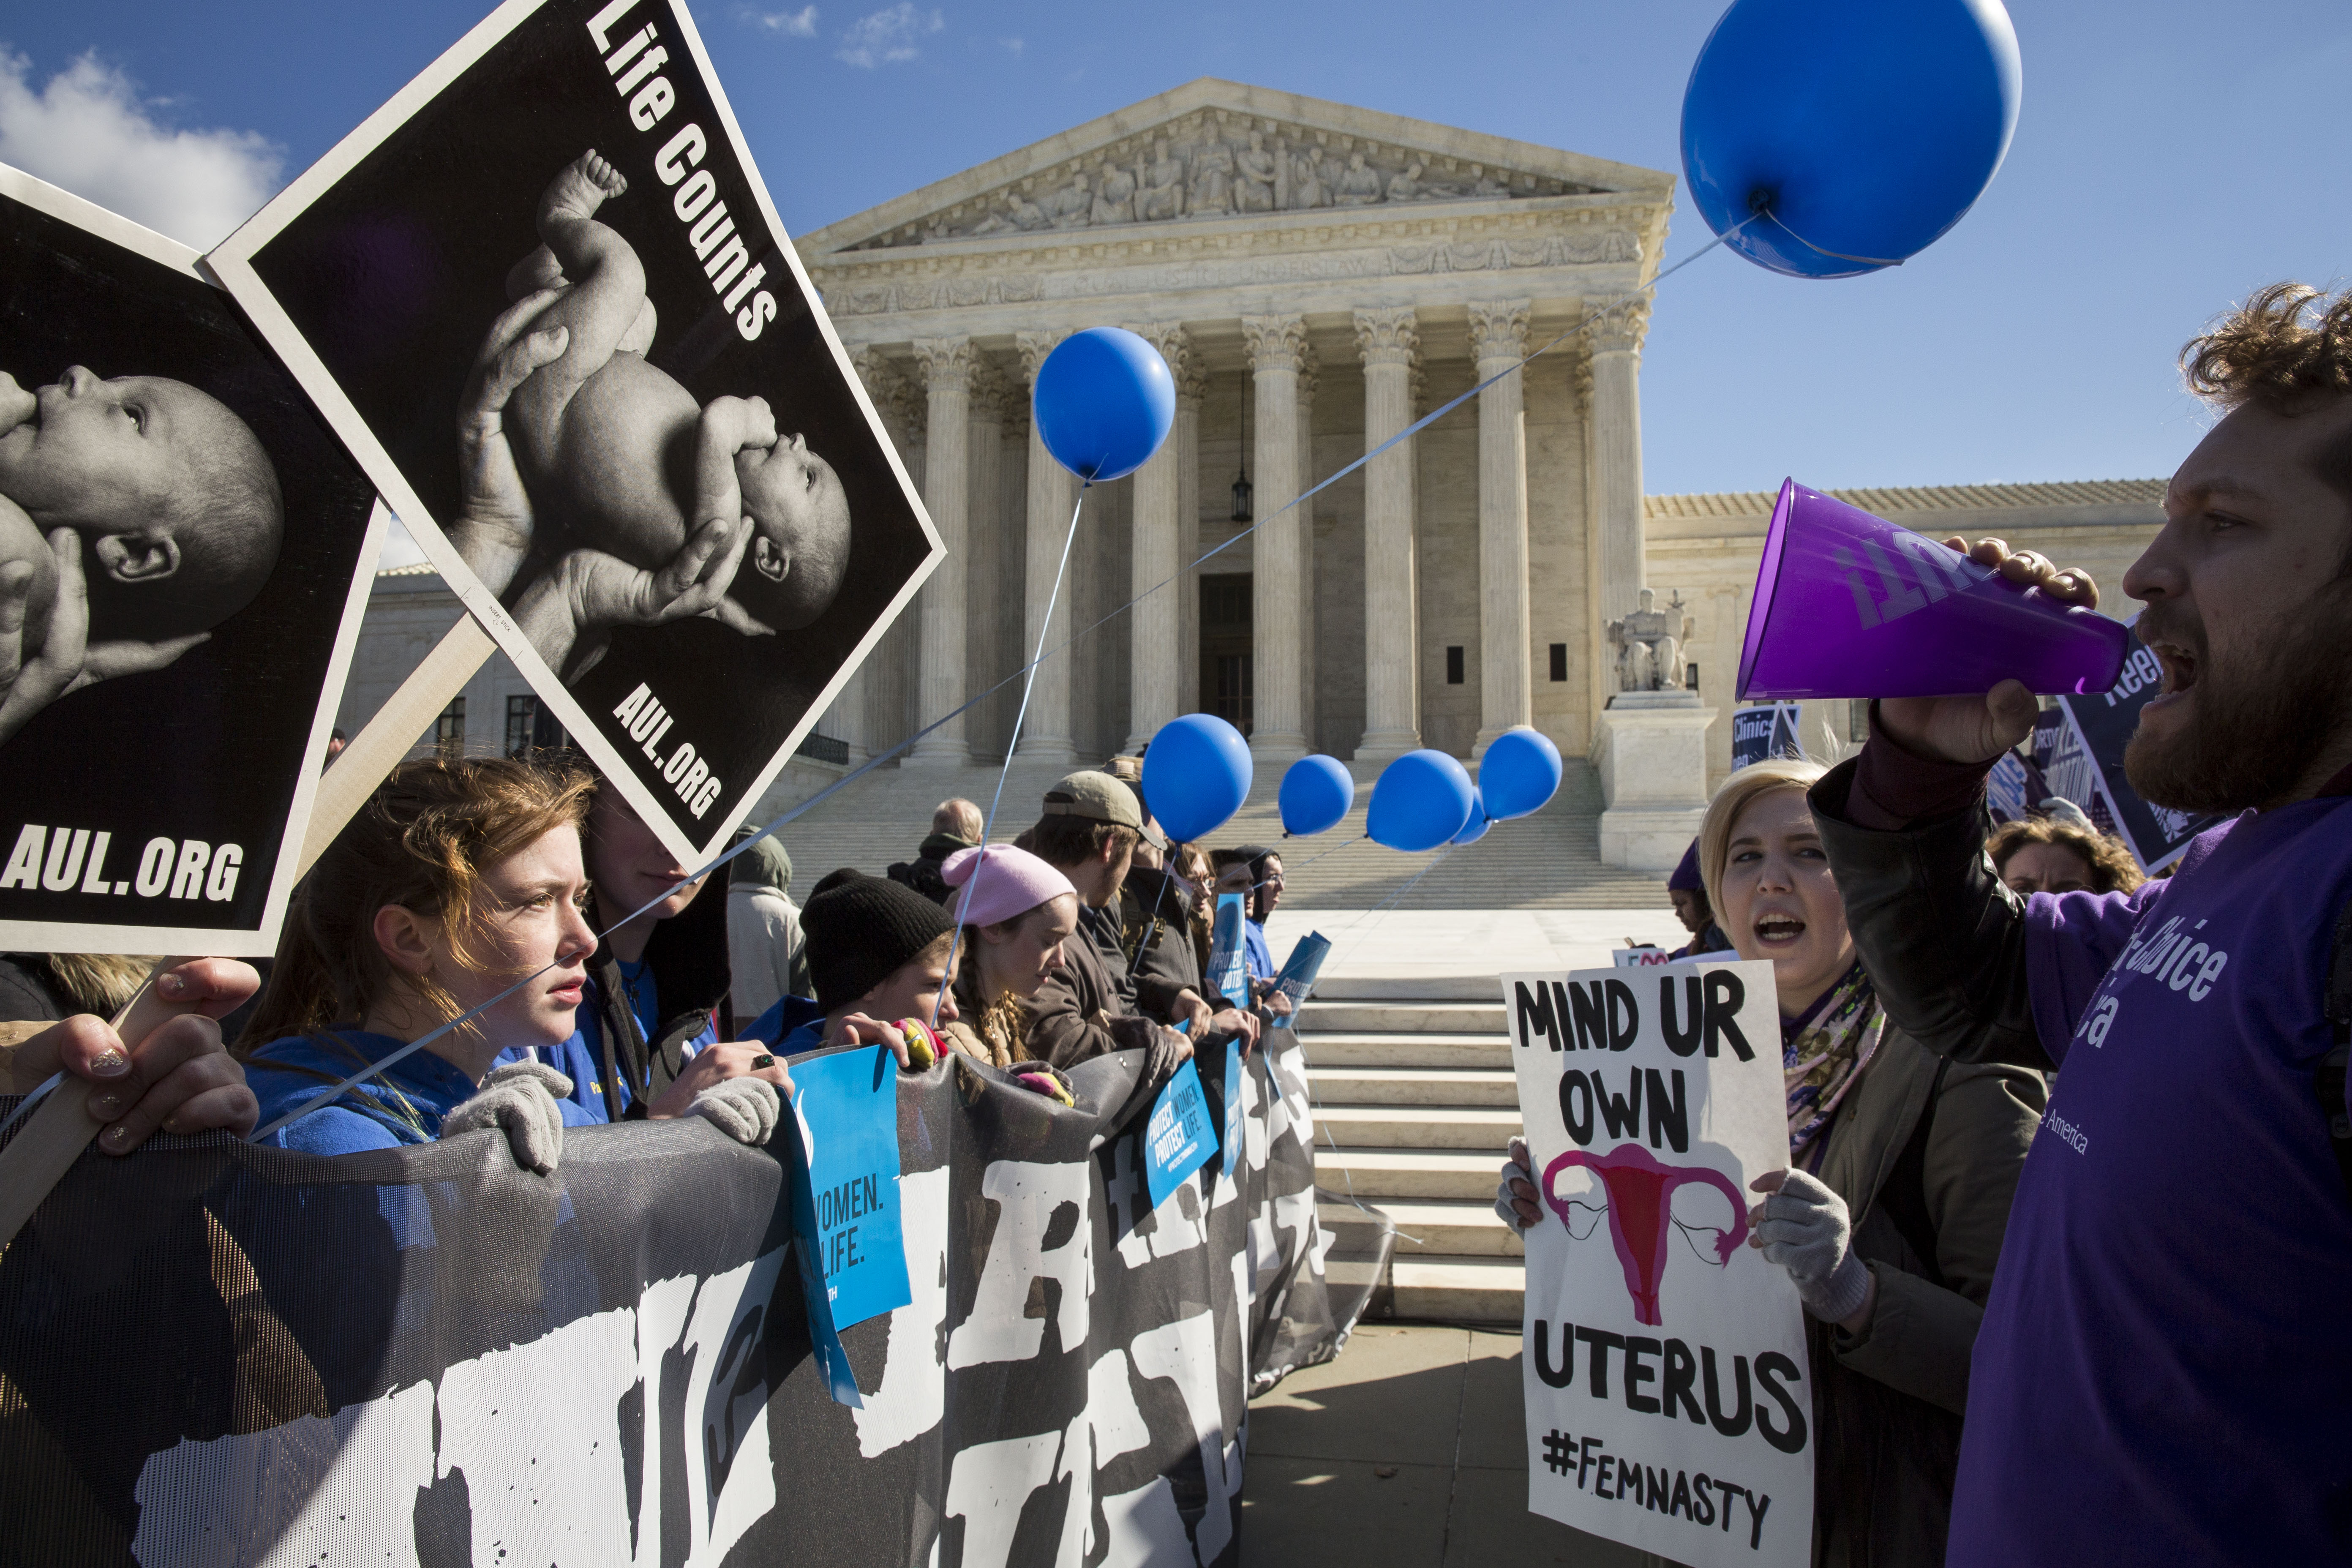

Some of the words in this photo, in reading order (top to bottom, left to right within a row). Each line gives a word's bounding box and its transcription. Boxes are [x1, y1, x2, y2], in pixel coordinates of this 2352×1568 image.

[586, 0, 675, 131] Life
[655, 123, 777, 341] Counts
[1143, 265, 1226, 288] JUSTICE
[488, 605, 501, 619] INSERT
[501, 620, 511, 633] STICK
[613, 682, 722, 820] AUL.ORG
[0, 824, 243, 901] AUL.ORG
[1515, 978, 1640, 1052] MIND
[1660, 969, 1755, 1062] UR
[1149, 1101, 1174, 1146] PROTECT
[1172, 1081, 1199, 1119] WOMEN.
[1155, 1121, 1186, 1168] PROTECT
[1183, 1110, 1202, 1140] LIFE.
[1559, 1065, 1689, 1153] OWN
[2046, 1108, 2088, 1155] America
[1534, 1319, 1807, 1454] UTERUS
[1542, 1429, 1771, 1551] #FEMNASTY
